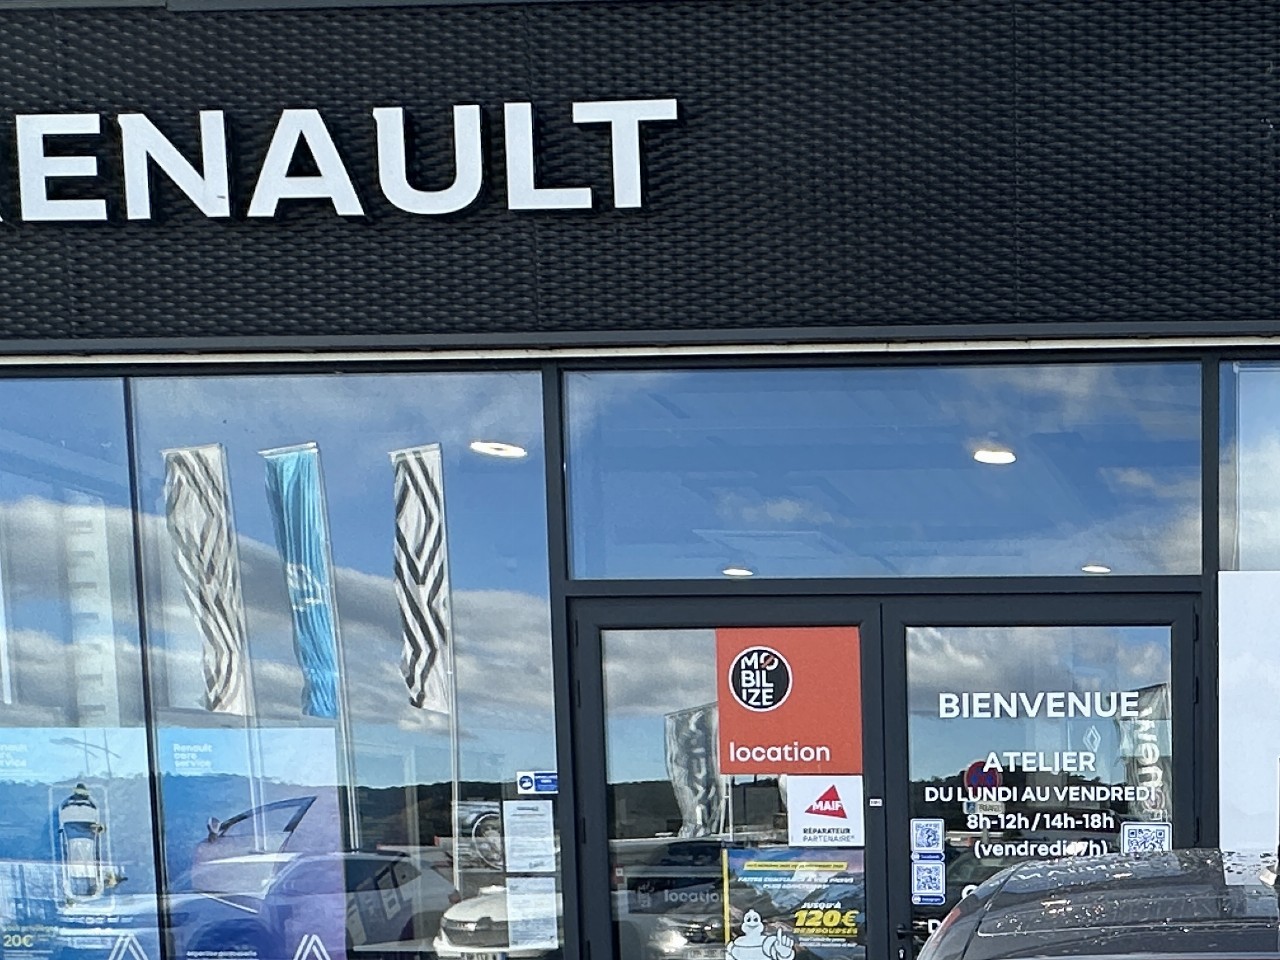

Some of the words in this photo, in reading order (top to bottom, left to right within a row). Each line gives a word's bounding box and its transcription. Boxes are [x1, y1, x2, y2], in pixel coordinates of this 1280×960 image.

[0, 98, 679, 222] ENAULT
[939, 692, 1139, 718] BIENVENUE
[729, 742, 830, 762] location
[983, 751, 1096, 773] ATELIER
[925, 786, 953, 801] DU
[957, 786, 1018, 801] LUNDI
[1021, 786, 1050, 801] AU
[1053, 786, 1156, 801] VENDREDI
[812, 800, 843, 811] MAIF
[974, 840, 1067, 859] (vendredi
[664, 889, 723, 903] locatio
[795, 910, 859, 927] 120€
